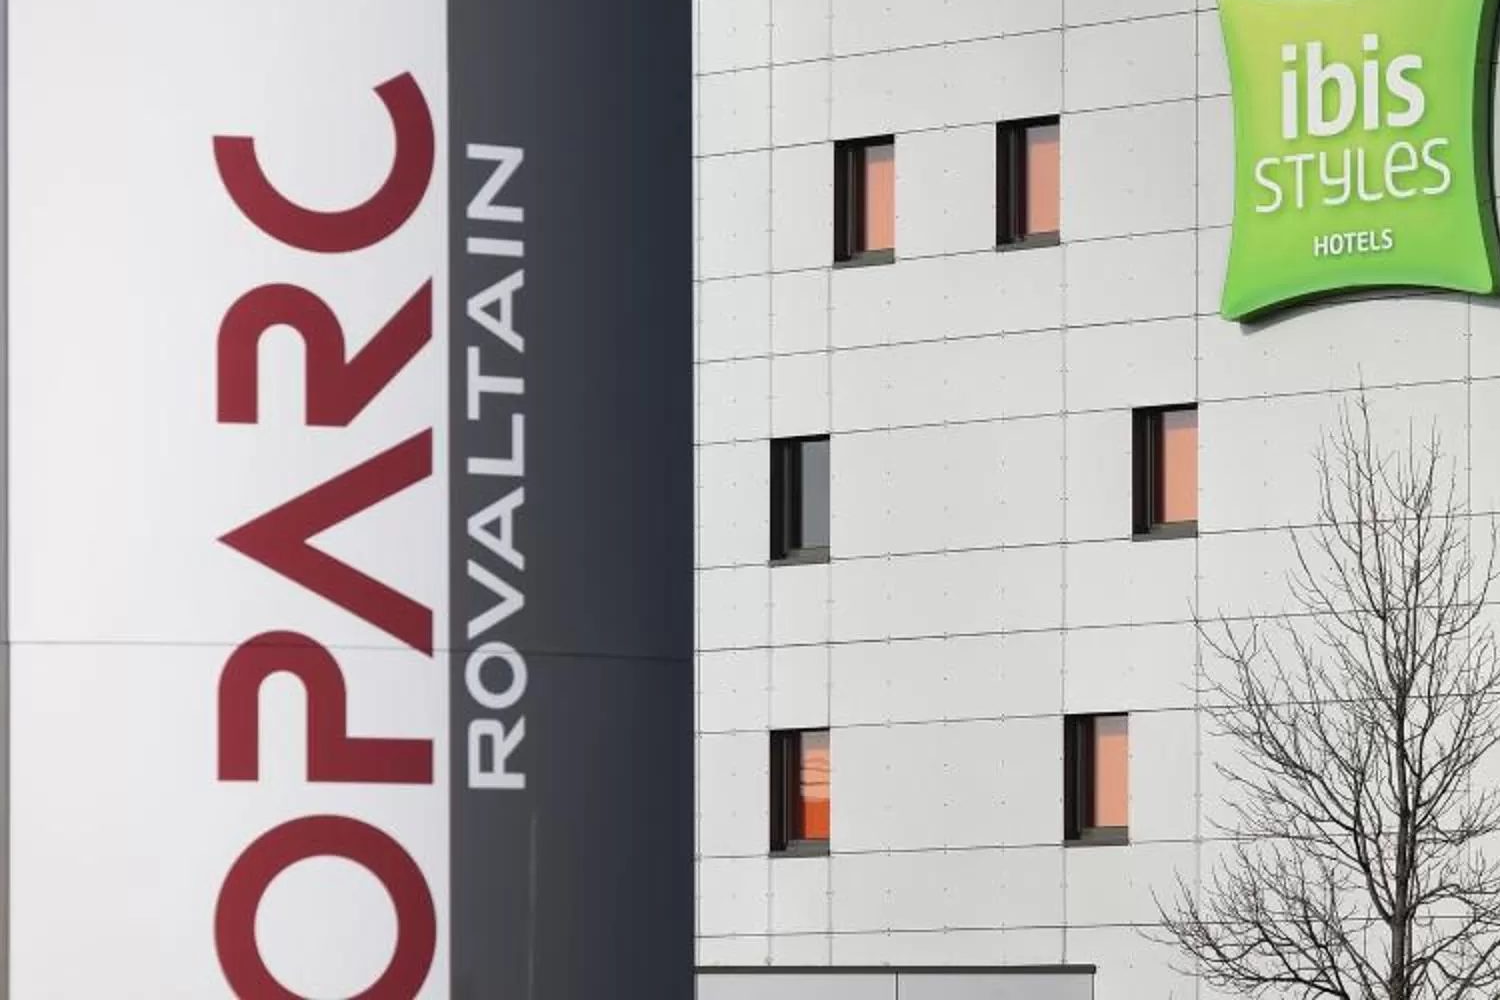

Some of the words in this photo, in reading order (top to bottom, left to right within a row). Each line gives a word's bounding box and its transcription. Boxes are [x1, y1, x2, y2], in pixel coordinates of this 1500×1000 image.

[1281, 33, 1426, 140] ibis
[1313, 228, 1394, 257] HOTELS
[465, 142, 528, 789] ROVALTAIN
